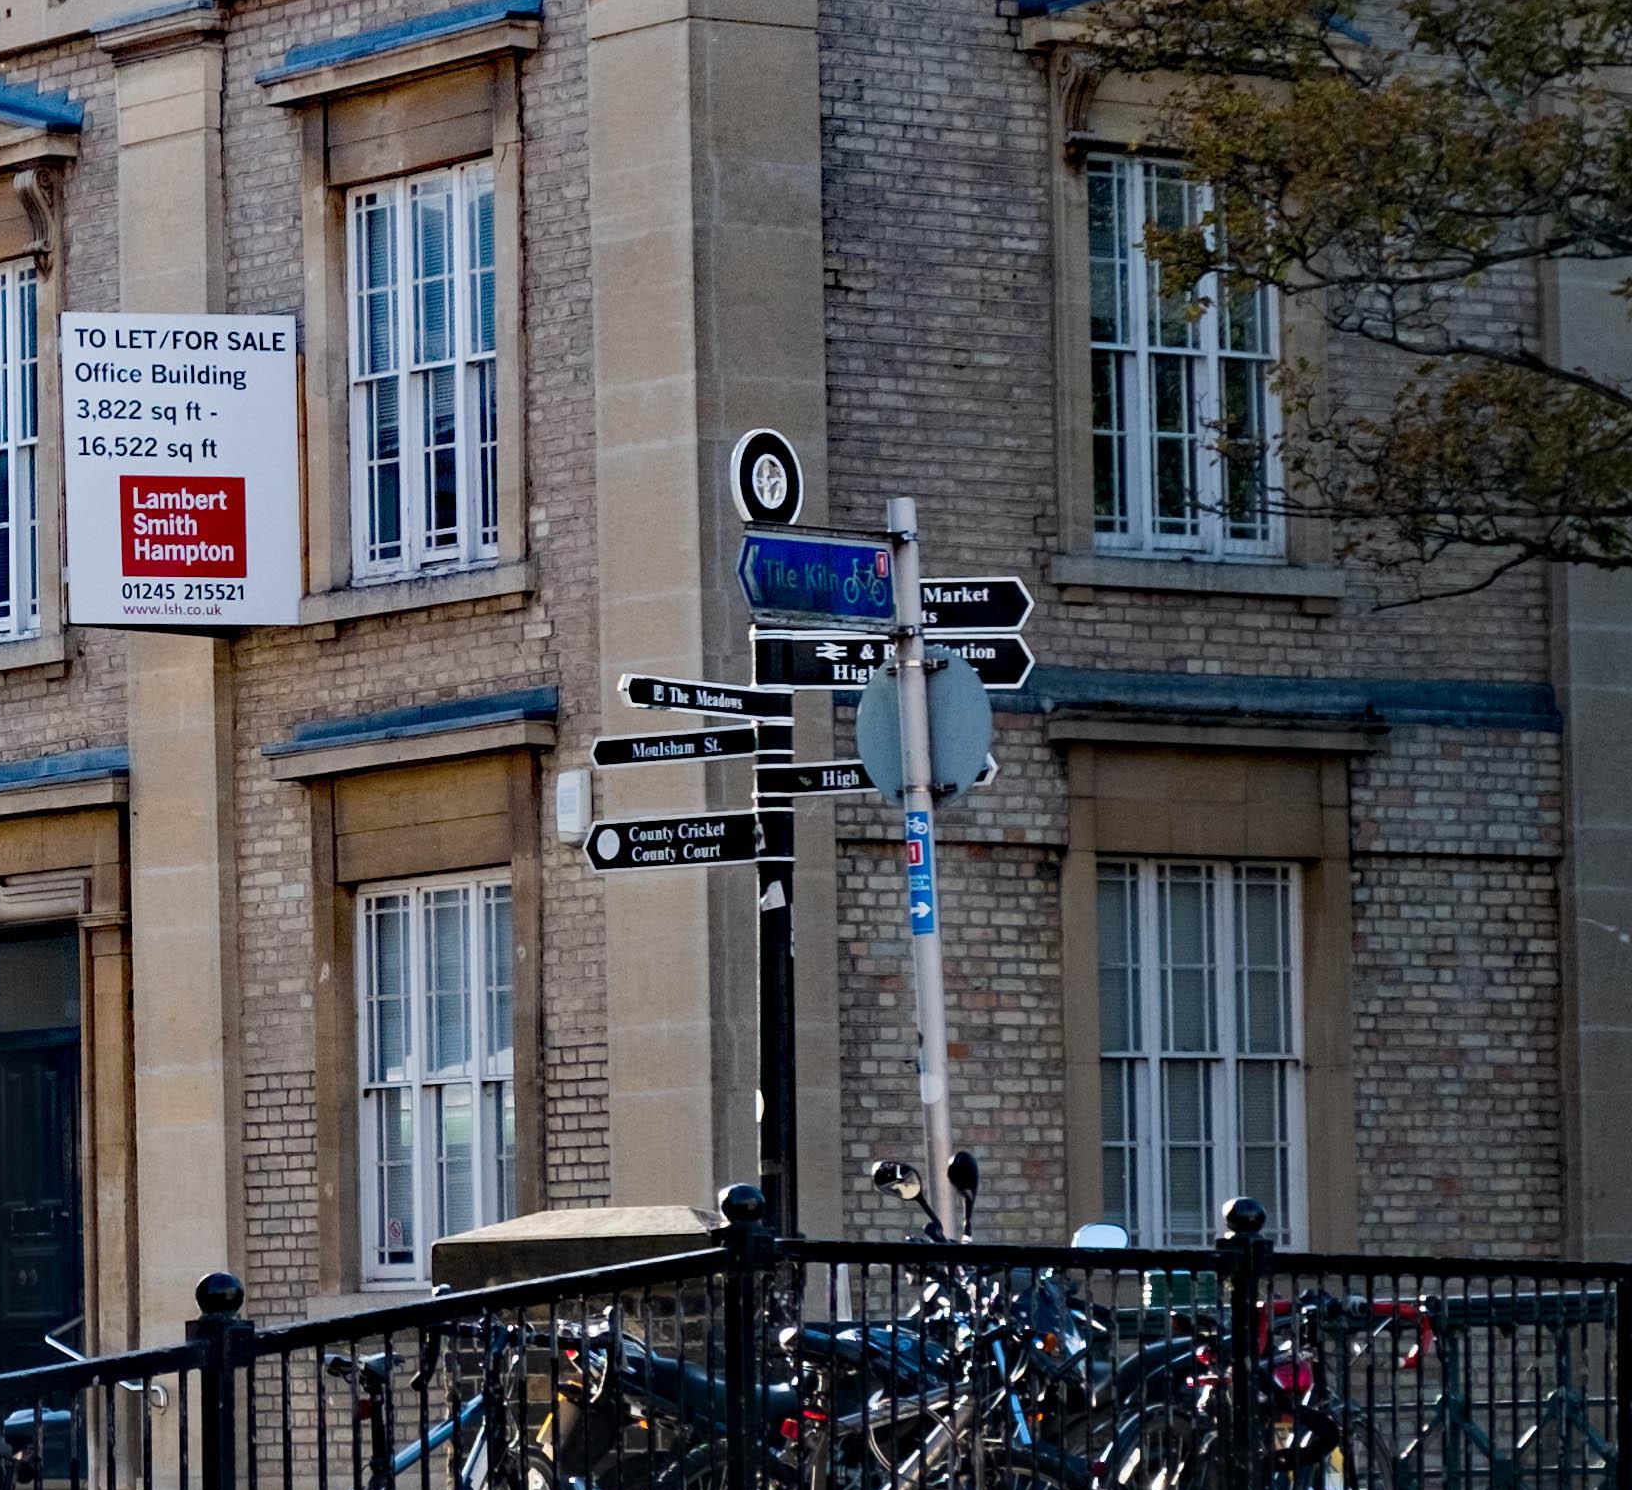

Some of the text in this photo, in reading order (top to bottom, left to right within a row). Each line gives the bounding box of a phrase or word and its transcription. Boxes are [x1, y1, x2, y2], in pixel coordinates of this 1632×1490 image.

[74, 328, 286, 352] TO LET/FOR SALE
[74, 362, 247, 390] Office Building
[76, 398, 143, 423] 3,822
[151, 404, 178, 425] sq
[186, 400, 202, 421] ft
[77, 436, 218, 462] 16,522 sq ft
[132, 486, 228, 511] Lambert
[133, 513, 199, 536] Smith
[134, 538, 235, 566] Hampton
[764, 558, 839, 592] Tile Kiln
[122, 582, 246, 602] 01245 215521
[923, 586, 990, 604] Market
[123, 602, 223, 616] www.lsh.co.uk
[668, 686, 689, 705] The
[695, 689, 743, 710] Meadows
[632, 741, 696, 759] Moulsham
[821, 769, 860, 789] High
[628, 821, 726, 844] County Cricket
[631, 843, 721, 863] County Court
